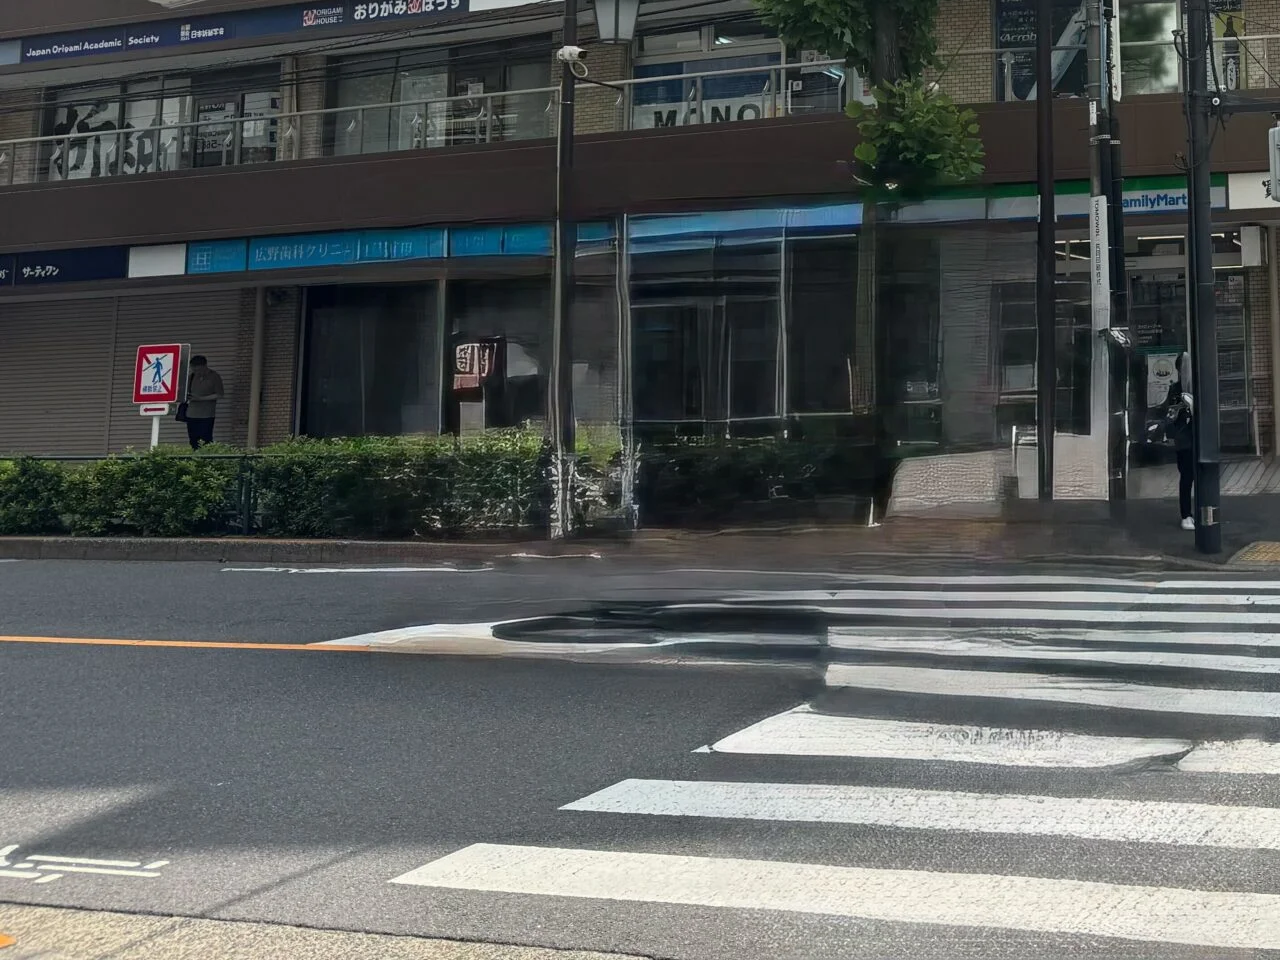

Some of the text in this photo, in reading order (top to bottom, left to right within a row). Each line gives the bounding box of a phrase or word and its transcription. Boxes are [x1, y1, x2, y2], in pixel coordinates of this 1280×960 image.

[316, 7, 343, 16] ORIGAMI
[316, 16, 337, 25] HOUSE
[26, 34, 160, 58] Japan Origami Academic Society
[1122, 194, 1187, 210] amilyMart
[22, 265, 59, 278] サーティワン
